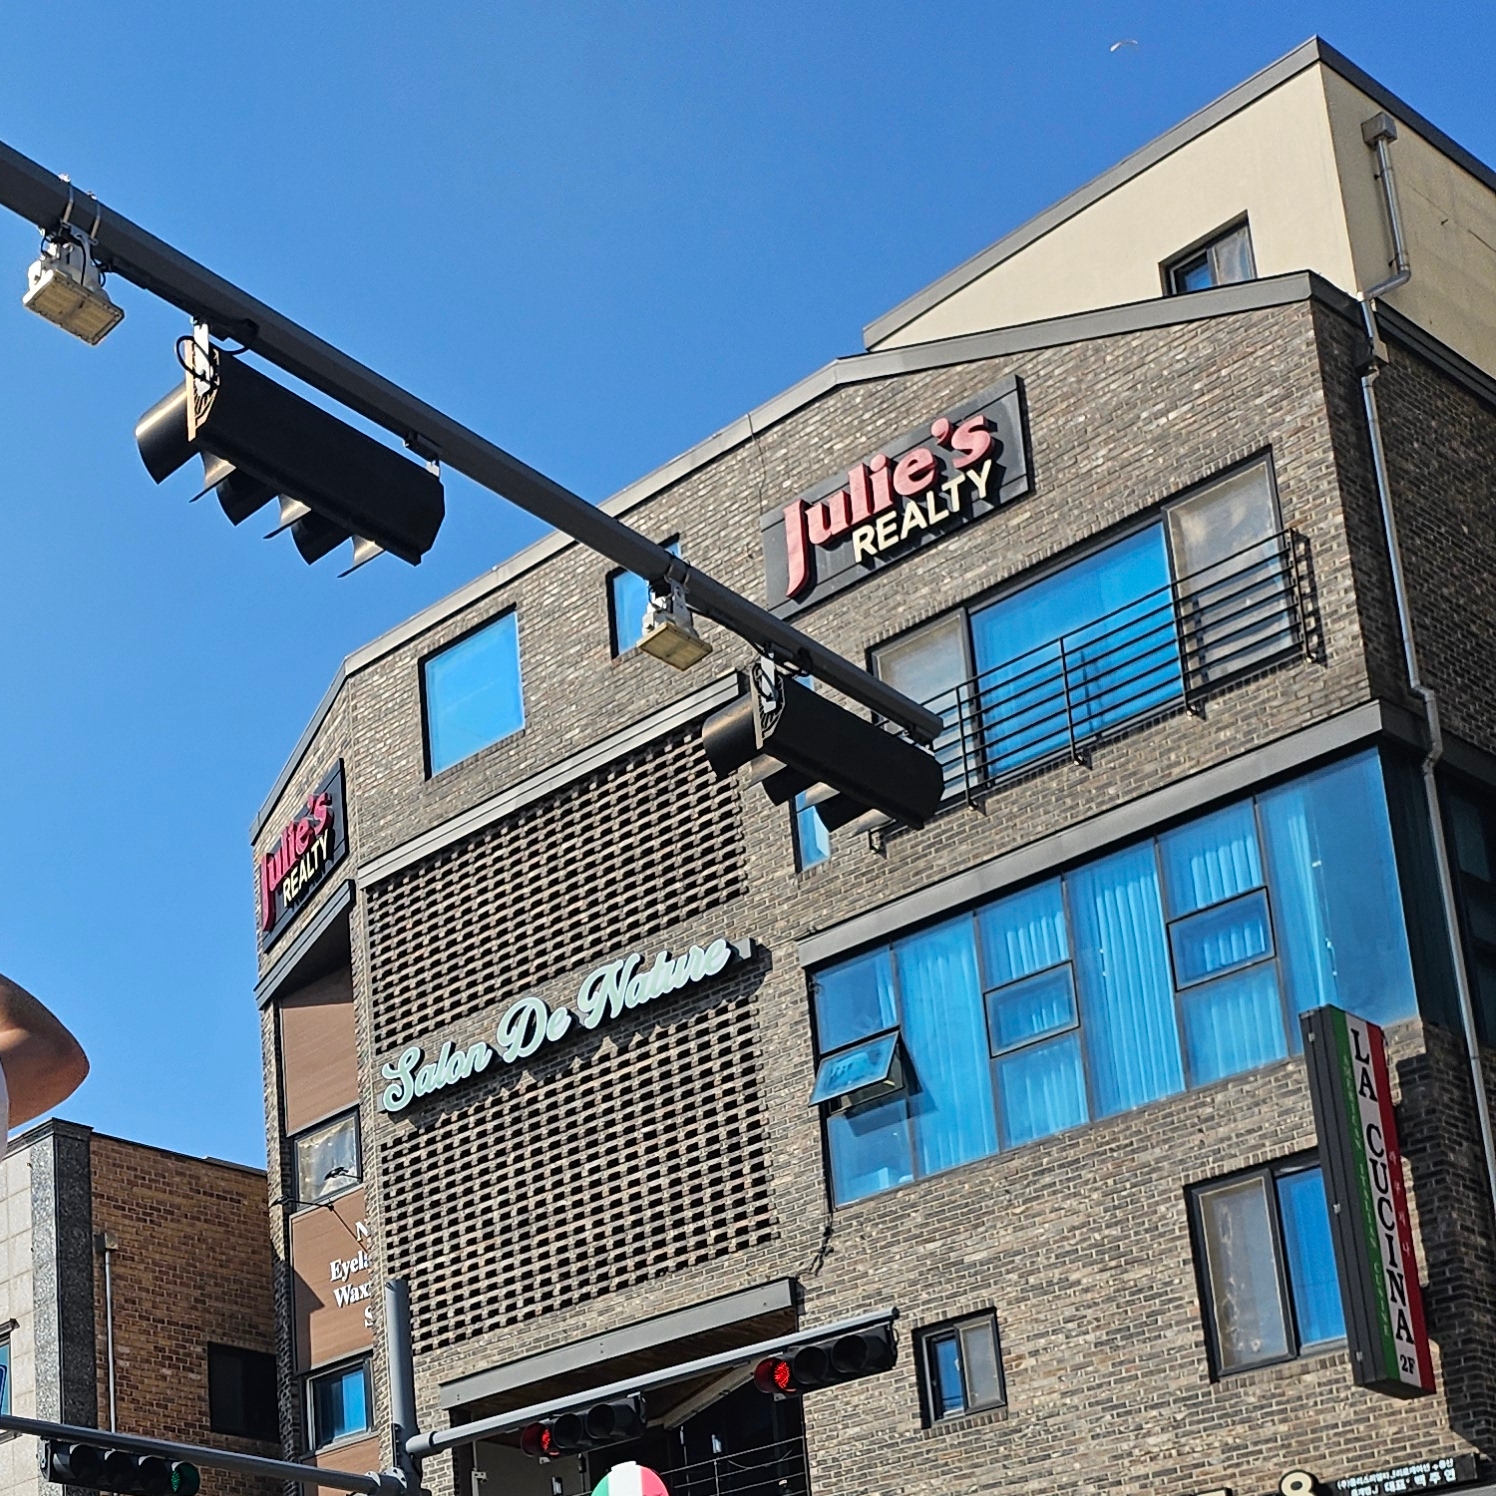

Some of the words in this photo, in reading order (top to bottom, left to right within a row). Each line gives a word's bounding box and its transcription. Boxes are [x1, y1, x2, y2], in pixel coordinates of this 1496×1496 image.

[783, 414, 994, 598] Julie's
[852, 459, 993, 563] REALTY
[260, 791, 334, 932] Julie's
[283, 828, 330, 908] REALTY
[382, 1041, 492, 1112] Salon
[496, 997, 572, 1063] De
[577, 938, 732, 1030] Nature
[1351, 1028, 1378, 1103] LA
[1366, 1122, 1414, 1346] CUCINA
[1400, 1355, 1416, 1374] 2F
